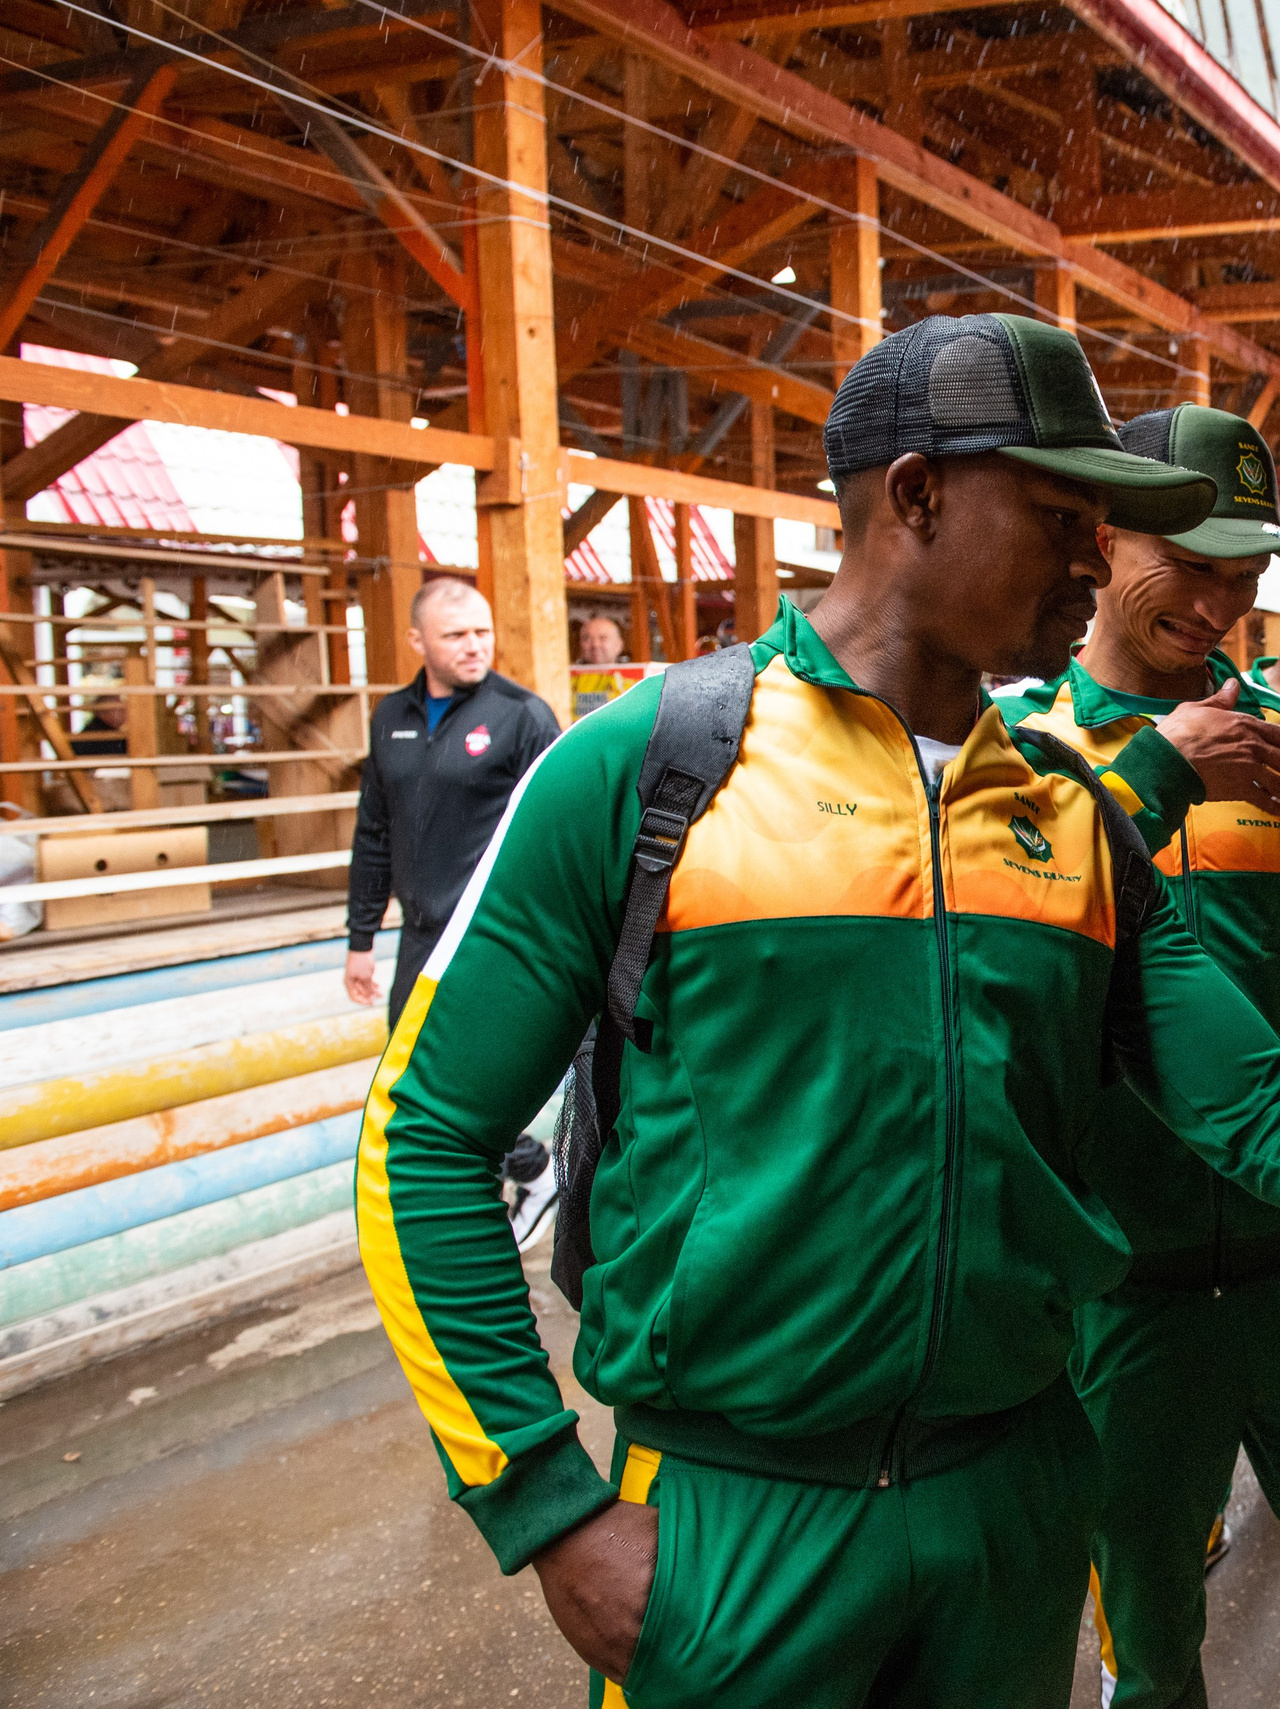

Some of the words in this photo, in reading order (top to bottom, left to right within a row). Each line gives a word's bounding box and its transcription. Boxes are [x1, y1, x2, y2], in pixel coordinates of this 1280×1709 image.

[1234, 496, 1260, 505] SEVENS
[816, 801, 858, 816] SILLY
[1236, 818, 1272, 828] SEVENS
[1003, 857, 1042, 878] SEVENS
